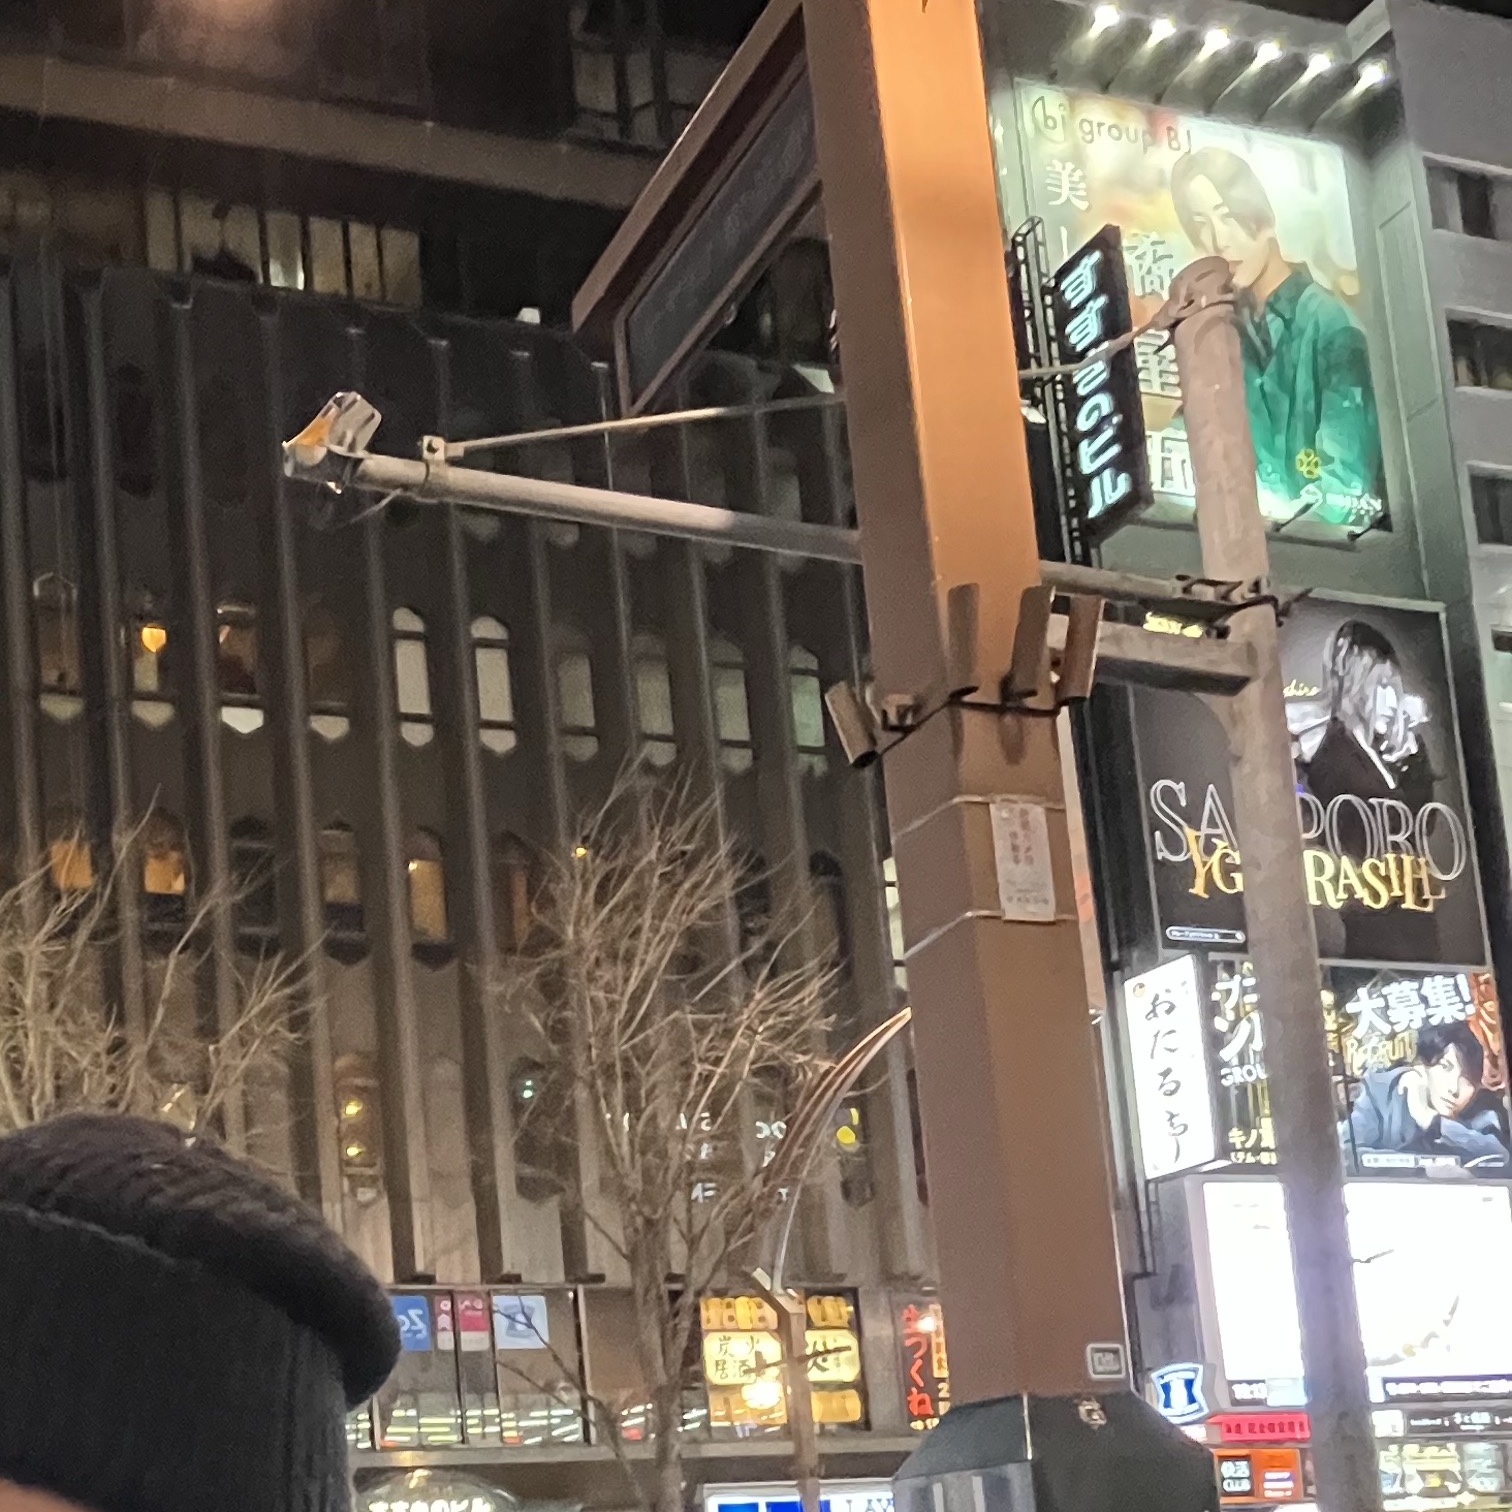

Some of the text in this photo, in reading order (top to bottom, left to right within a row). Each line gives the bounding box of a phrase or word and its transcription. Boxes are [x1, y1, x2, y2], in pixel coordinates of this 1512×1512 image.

[1078, 118, 1156, 154] group
[1149, 779, 1467, 881] SAPORO
[1183, 825, 1446, 913] YGRASILL
[1345, 973, 1476, 1039] 大募集!
